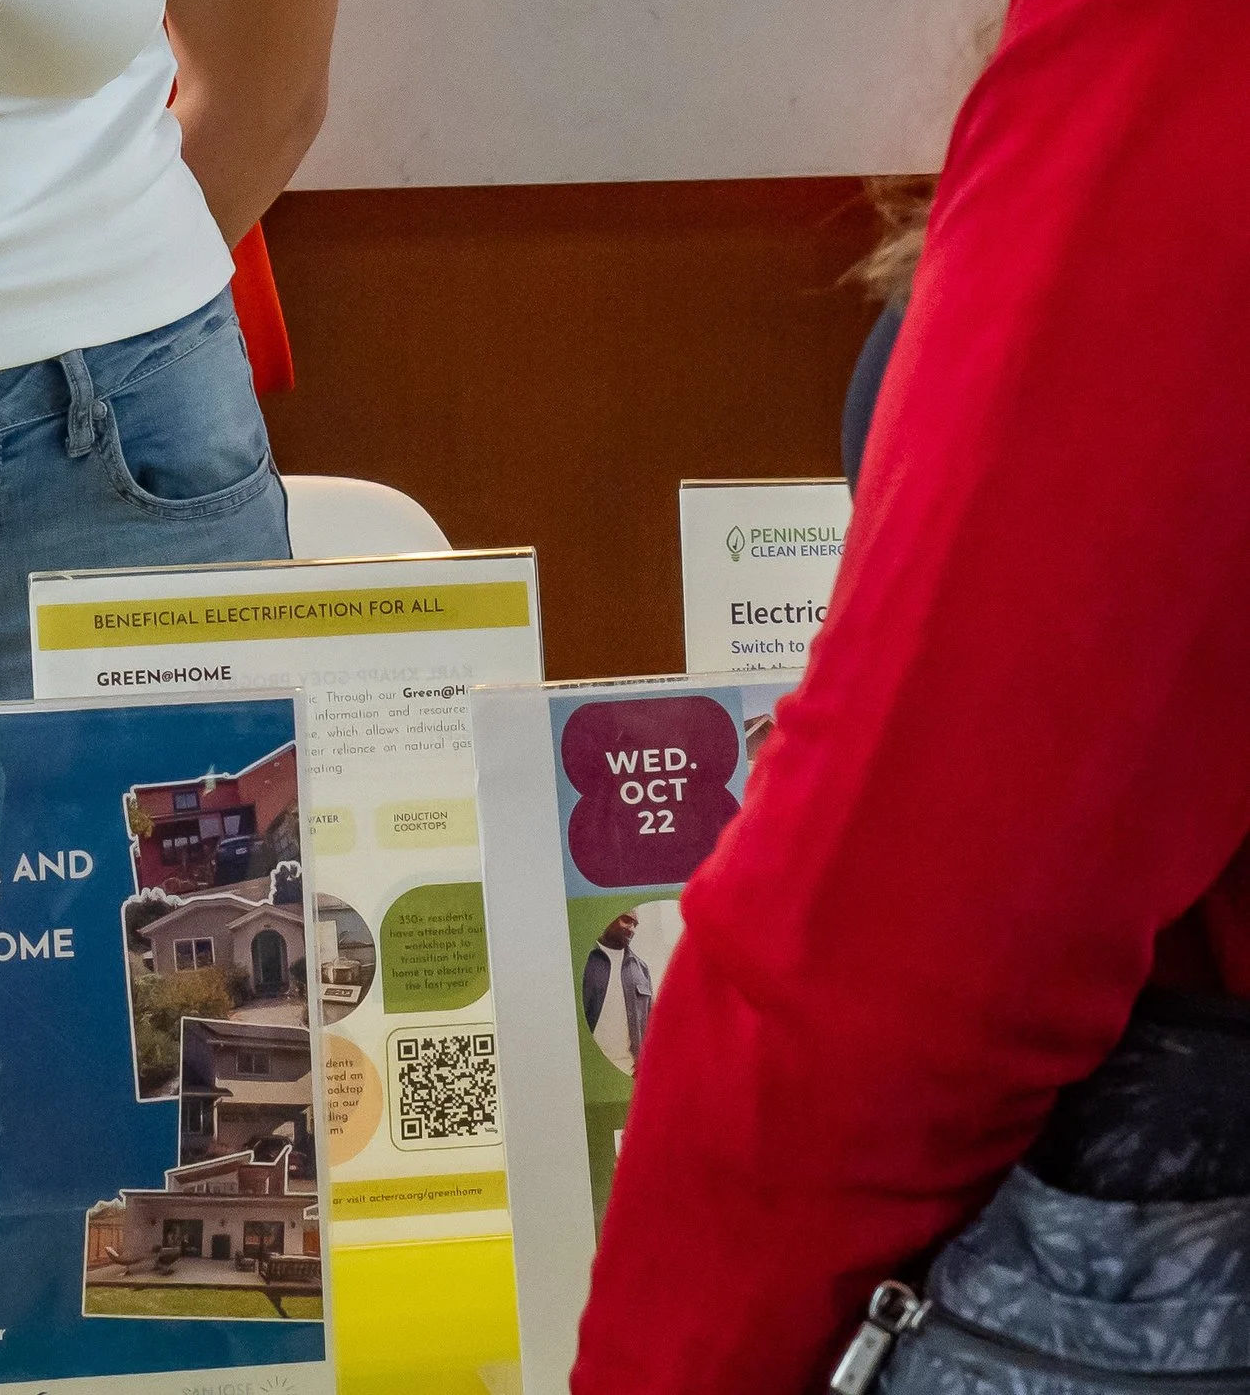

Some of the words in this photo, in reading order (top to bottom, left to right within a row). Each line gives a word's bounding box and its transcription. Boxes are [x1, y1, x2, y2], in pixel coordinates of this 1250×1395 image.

[751, 546, 796, 557] CLEAN
[94, 611, 198, 629] BENEFICIAL
[206, 602, 362, 623] ELECTRIFICATION
[370, 600, 404, 616] FOR
[412, 598, 444, 613] ALL
[732, 600, 827, 624] Electric
[732, 639, 784, 654] Switch
[789, 640, 804, 652] to
[97, 666, 231, 686] GREEN@HOME
[326, 690, 372, 703] Through
[403, 685, 468, 699] Green@H
[316, 709, 379, 720] information
[388, 705, 410, 717] and
[327, 725, 358, 737] which
[366, 724, 399, 735] allows
[407, 720, 465, 733] individuals
[333, 743, 376, 755] reliance
[405, 738, 446, 750] natural
[606, 748, 697, 774] WED.
[620, 778, 687, 804] OCT
[394, 812, 447, 822] INDUCTION
[638, 810, 675, 834] 22
[394, 822, 446, 832] COOKTOPS
[13, 850, 93, 882] AND
